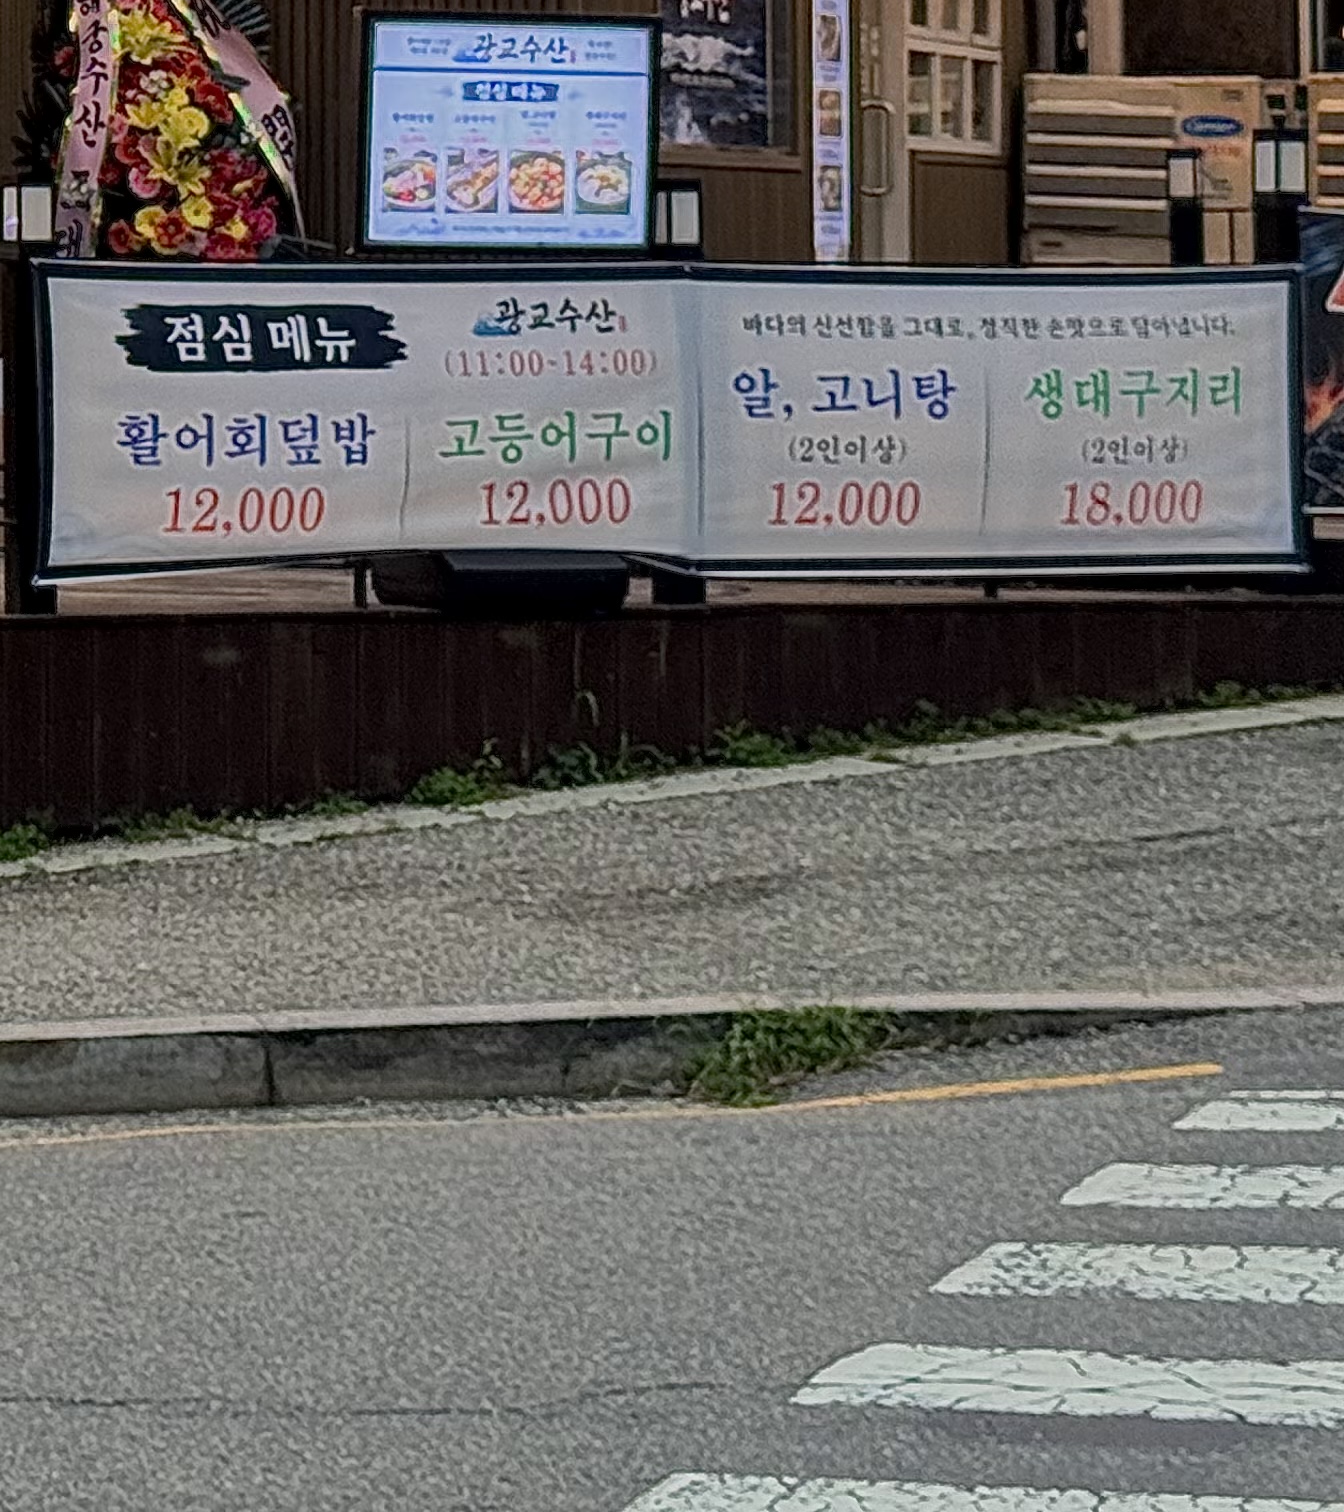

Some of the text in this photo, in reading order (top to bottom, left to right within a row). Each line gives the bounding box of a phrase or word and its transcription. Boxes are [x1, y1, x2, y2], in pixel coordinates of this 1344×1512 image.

[474, 33, 570, 64] 광교수산
[164, 311, 358, 364] 점심 메뉴
[495, 297, 617, 335] 광교수산
[444, 348, 658, 378] (11:00-14:00)
[813, 368, 957, 420] 고니탕
[1024, 366, 1241, 420] 생대구지리
[116, 412, 377, 467] 활어회덮밥
[437, 409, 674, 463] 고등어구이
[788, 434, 907, 465] (2인이상)
[1082, 433, 1189, 465] (2인이상)
[162, 486, 325, 538] 12,000
